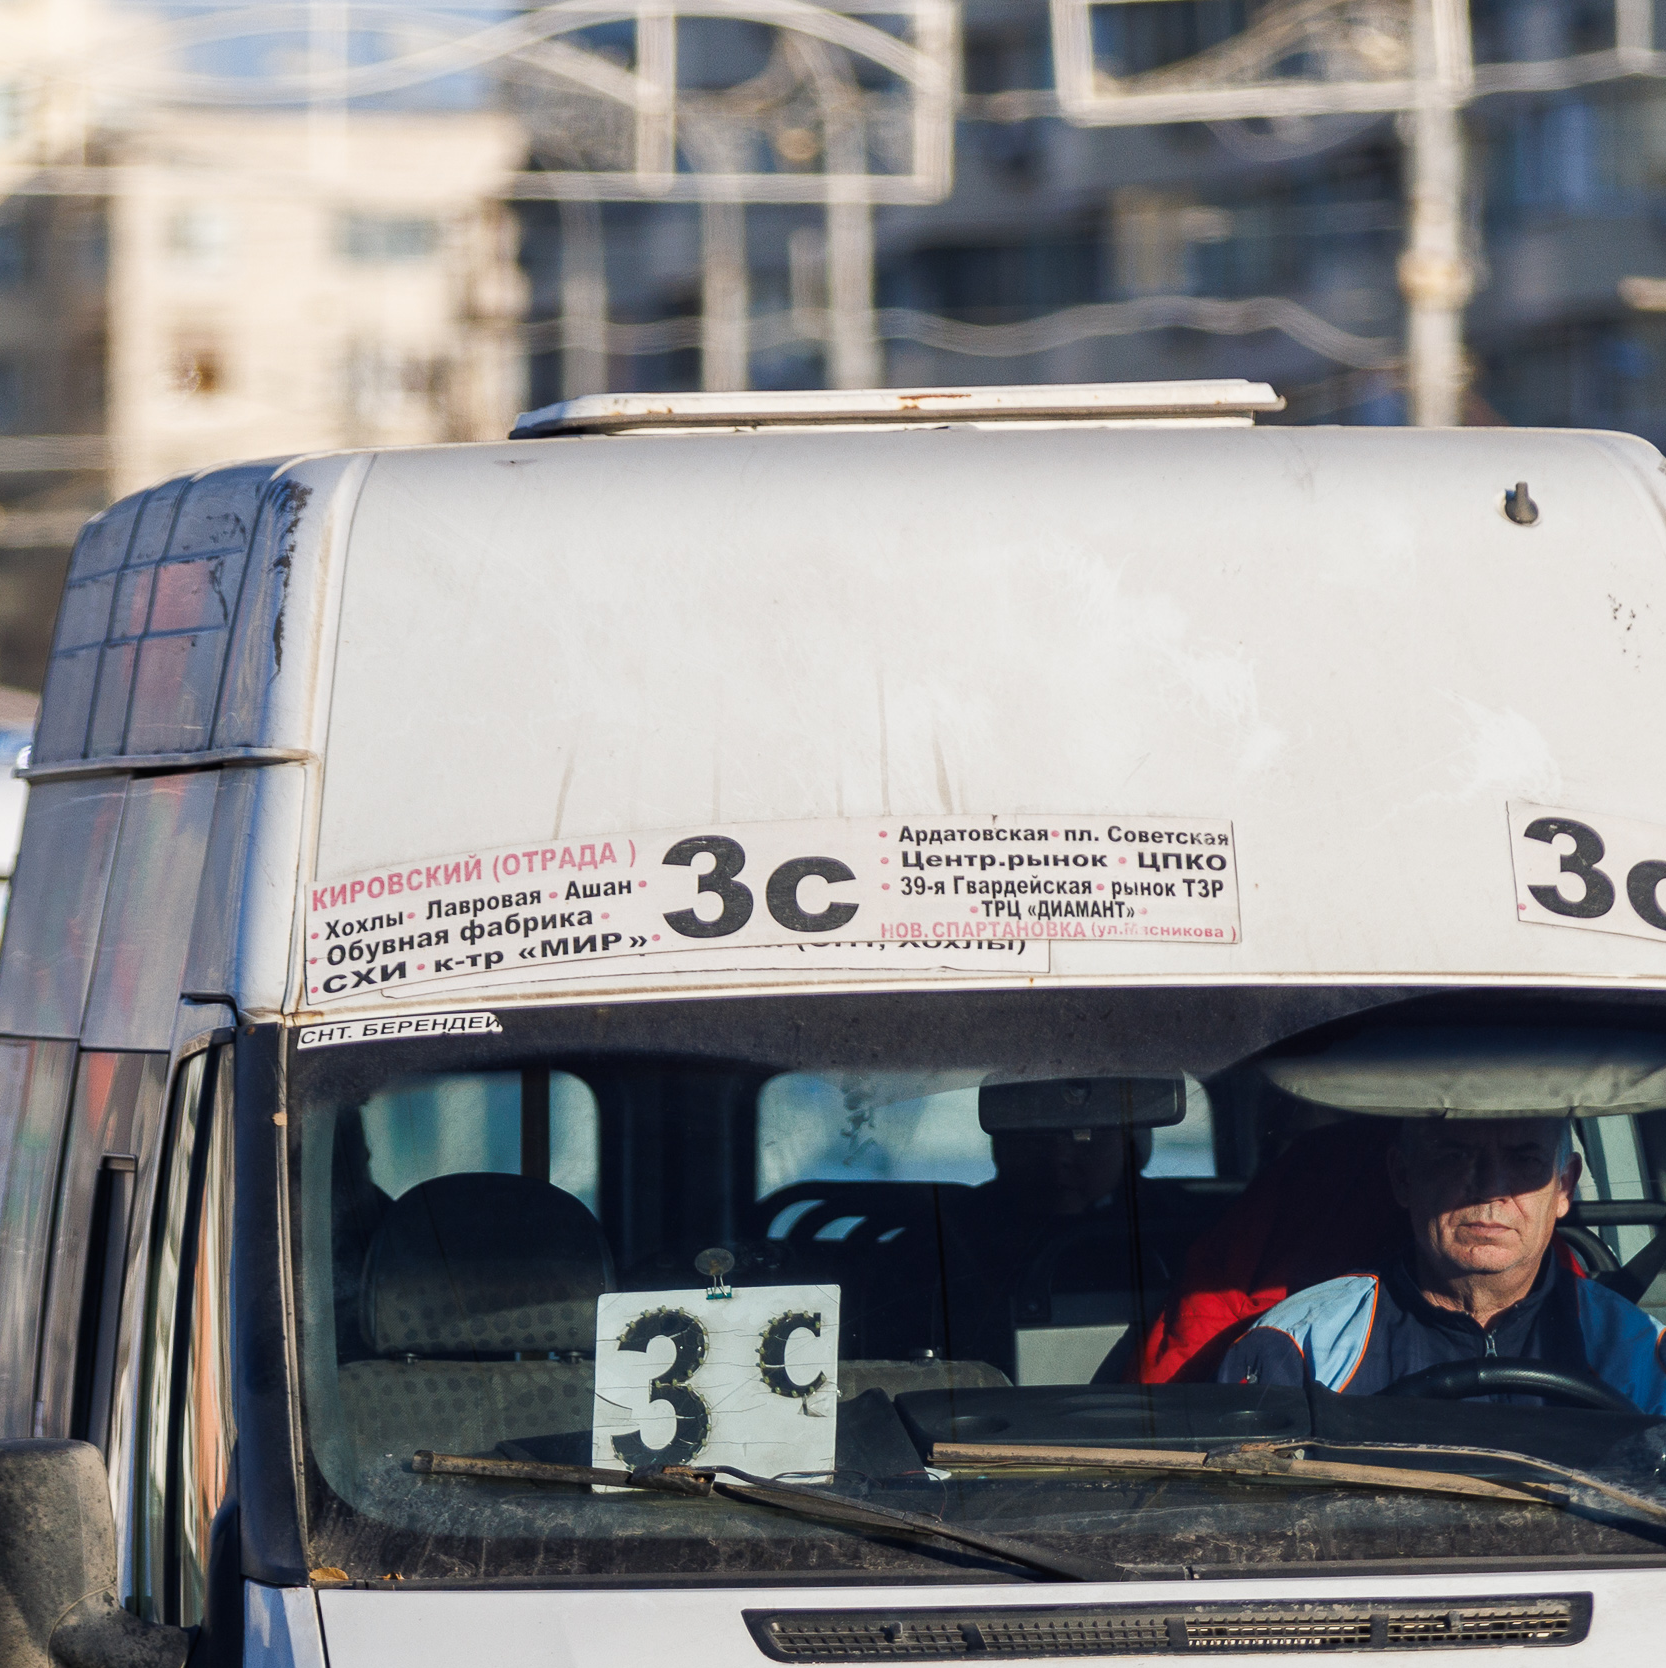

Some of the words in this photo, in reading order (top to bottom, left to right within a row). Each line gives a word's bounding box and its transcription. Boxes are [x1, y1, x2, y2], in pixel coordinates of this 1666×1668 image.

[899, 826, 1049, 844] Ардатовская
[1064, 829, 1100, 842] пл.
[1107, 825, 1229, 846] Советская
[901, 850, 1108, 871] Центр.рынок
[1137, 852, 1228, 872] ЦПКО
[312, 855, 482, 912] КИРОВСКИЙ
[900, 876, 946, 896] 39-я
[953, 875, 1093, 899] Гвардейская
[1111, 880, 1176, 899] рынок
[325, 911, 404, 941] Хохлы
[426, 888, 542, 921] Лавровая
[564, 880, 633, 901] Ашан
[982, 900, 1023, 920] ТРЦ
[1027, 900, 1136, 921] «ДИАМАНТ»
[326, 929, 449, 967] Обувная
[460, 909, 593, 946] фабрика
[322, 961, 407, 995] СХИ
[434, 951, 504, 974] к-тр
[300, 1026, 353, 1046] СНТ.
